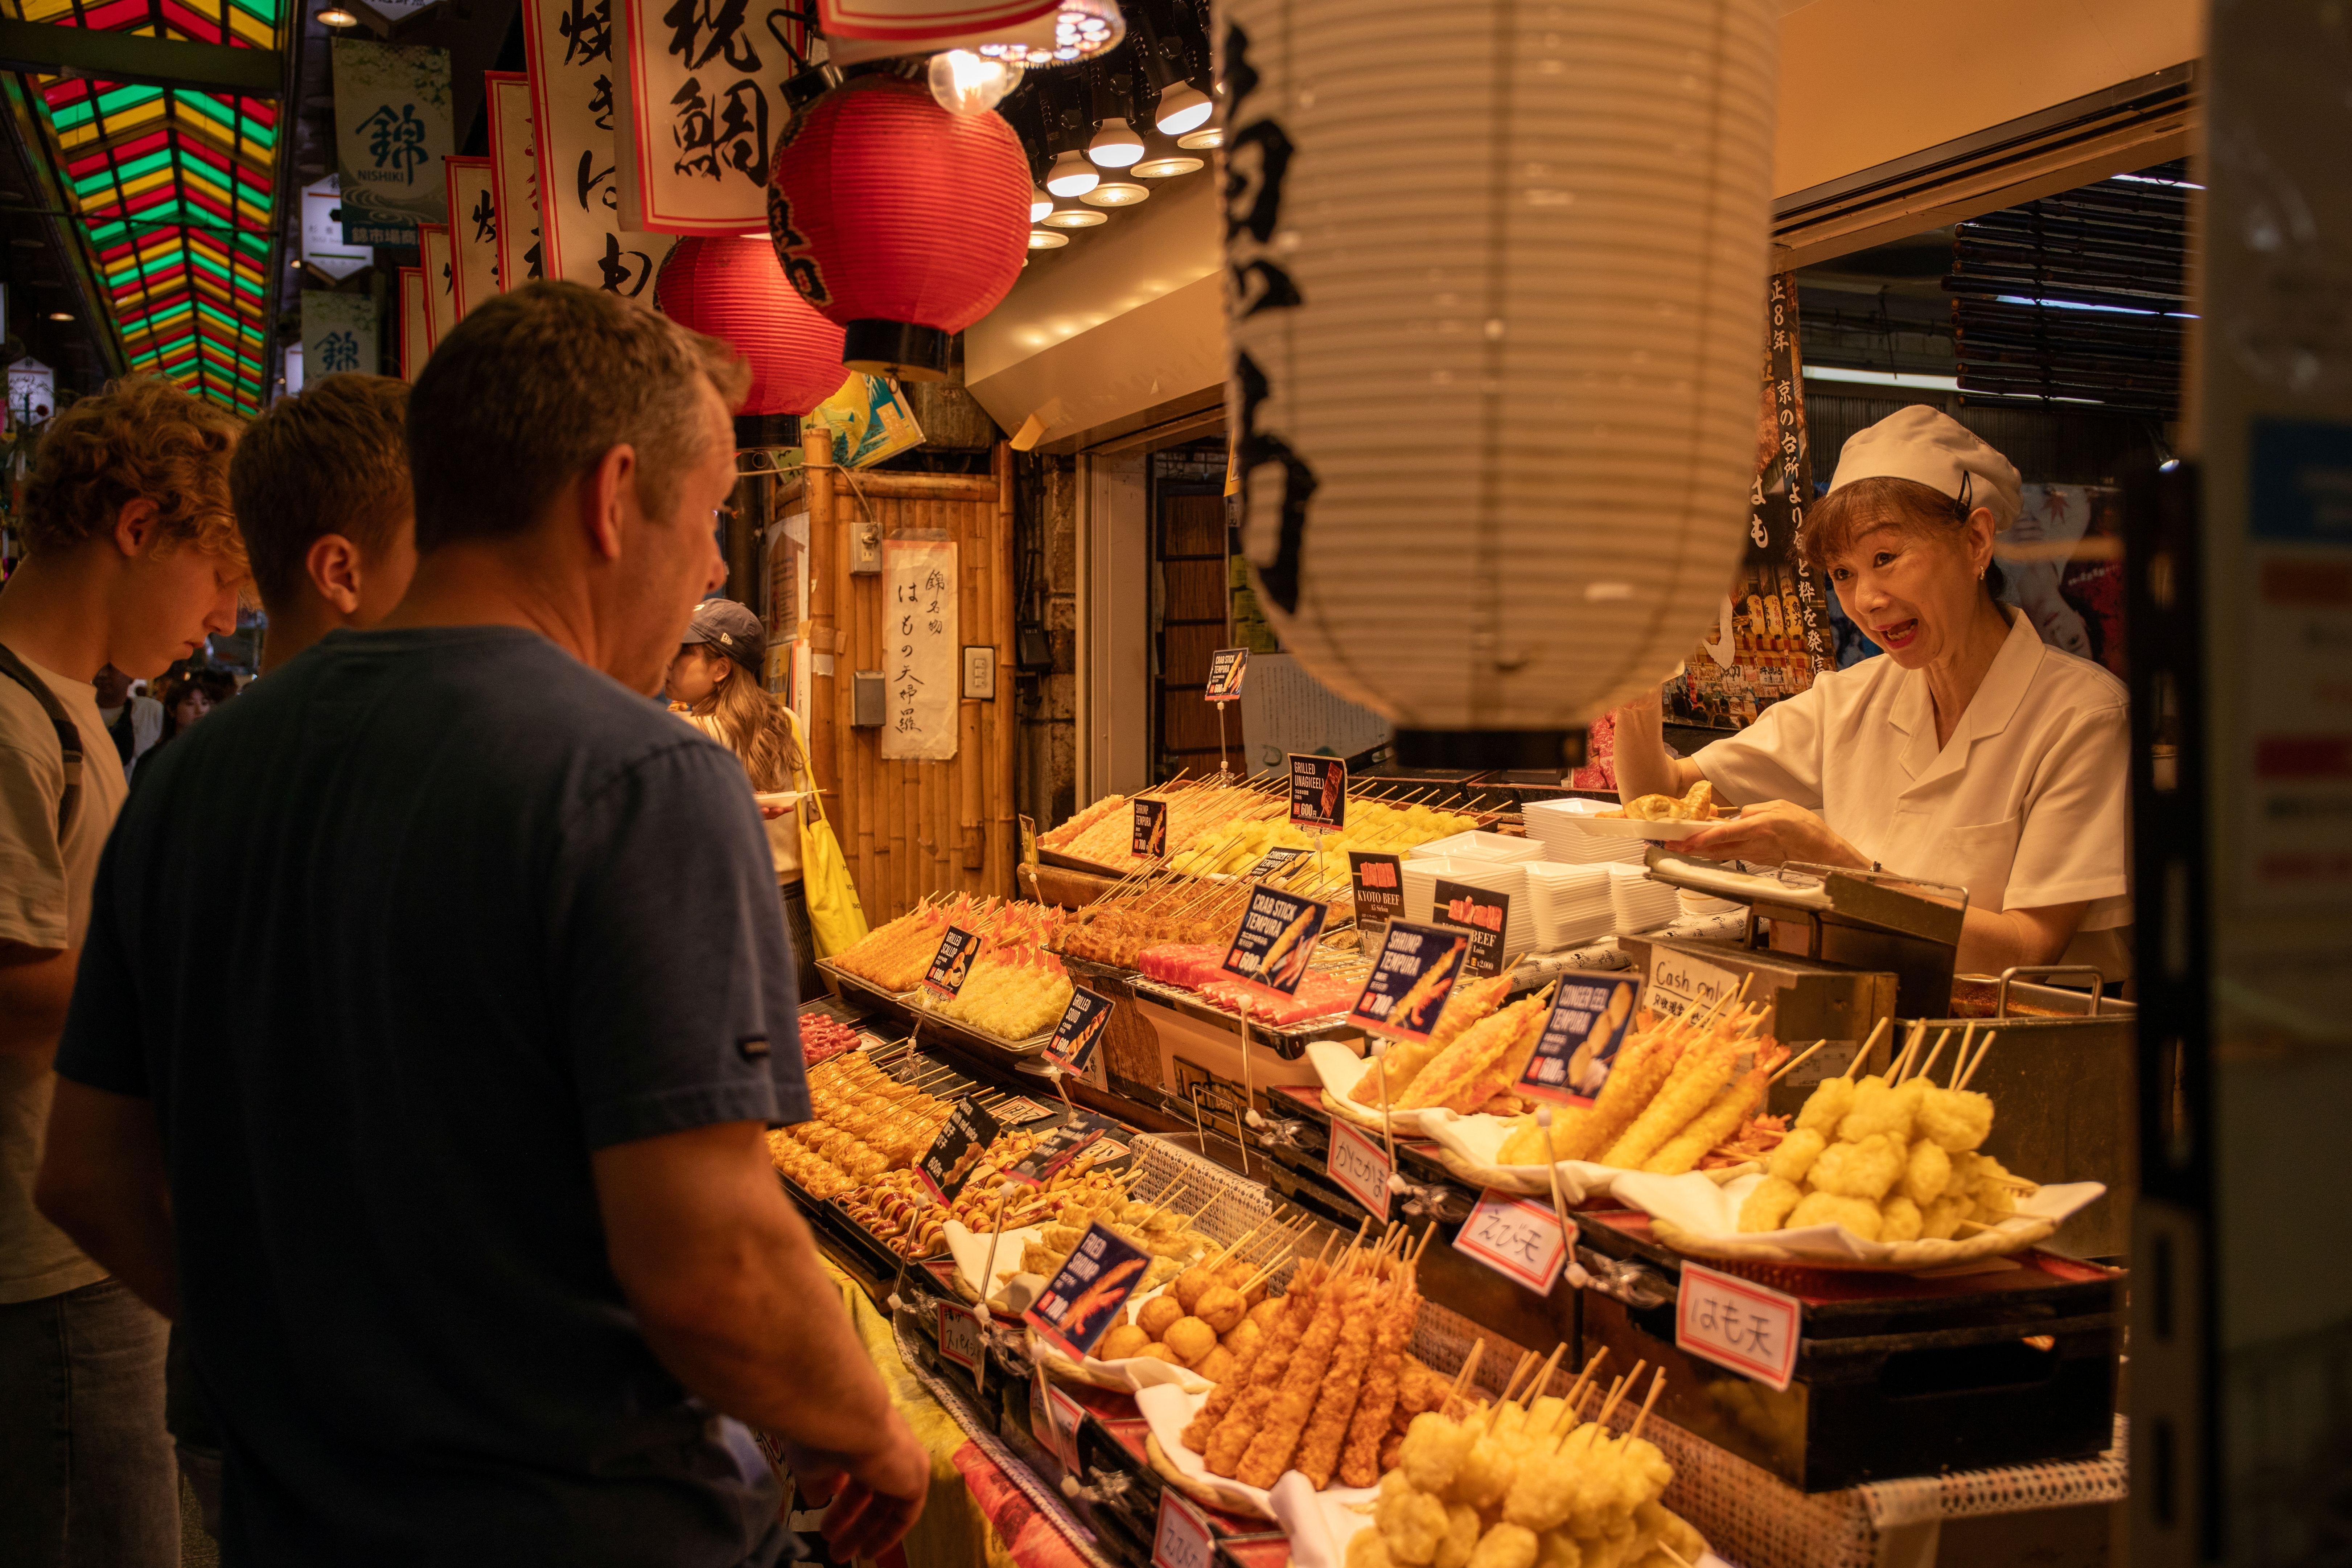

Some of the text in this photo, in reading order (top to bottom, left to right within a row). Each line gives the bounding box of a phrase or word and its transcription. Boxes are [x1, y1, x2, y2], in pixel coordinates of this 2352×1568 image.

[355, 103, 429, 186] 錦
[357, 170, 404, 182] NISHIKI
[925, 569, 946, 635] 錦名物
[1792, 601, 1803, 627] 魚力
[1215, 655, 1235, 664] CRAB STICK
[1214, 665, 1230, 674] TEMPURA
[1294, 762, 1315, 775] GRILLED
[1295, 775, 1324, 790] UNAGI(EEL)
[1136, 804, 1148, 815] SHRIMP
[1301, 803, 1317, 817] 600円
[1136, 815, 1151, 827] TEMPURA
[1358, 890, 1399, 905] KYOTO BEEF
[1253, 894, 1298, 922] CRAB STICK
[1246, 911, 1283, 938] TEMPURA
[946, 931, 962, 947] GRILLED
[1388, 930, 1423, 955] SHRIMP
[1472, 930, 1497, 947] BEEF
[941, 943, 958, 958] SCALLOP
[1473, 944, 1485, 955] Loin
[1380, 950, 1422, 977] TEMPURA
[1656, 961, 1690, 992] Cash
[1072, 993, 1091, 1012] GRILLED
[1590, 987, 1610, 1011] EEL
[1066, 1007, 1081, 1024] SQUID
[1549, 1008, 1592, 1035] TEMPURA
[959, 1097, 974, 1116] Gyoza
[951, 1111, 962, 1125] with
[958, 1118, 970, 1132] red
[927, 1156, 943, 1178] 600円
[1479, 1209, 1542, 1263] えび天
[1067, 1251, 1101, 1283] SHRIMP
[1691, 1297, 1772, 1357] はも天
